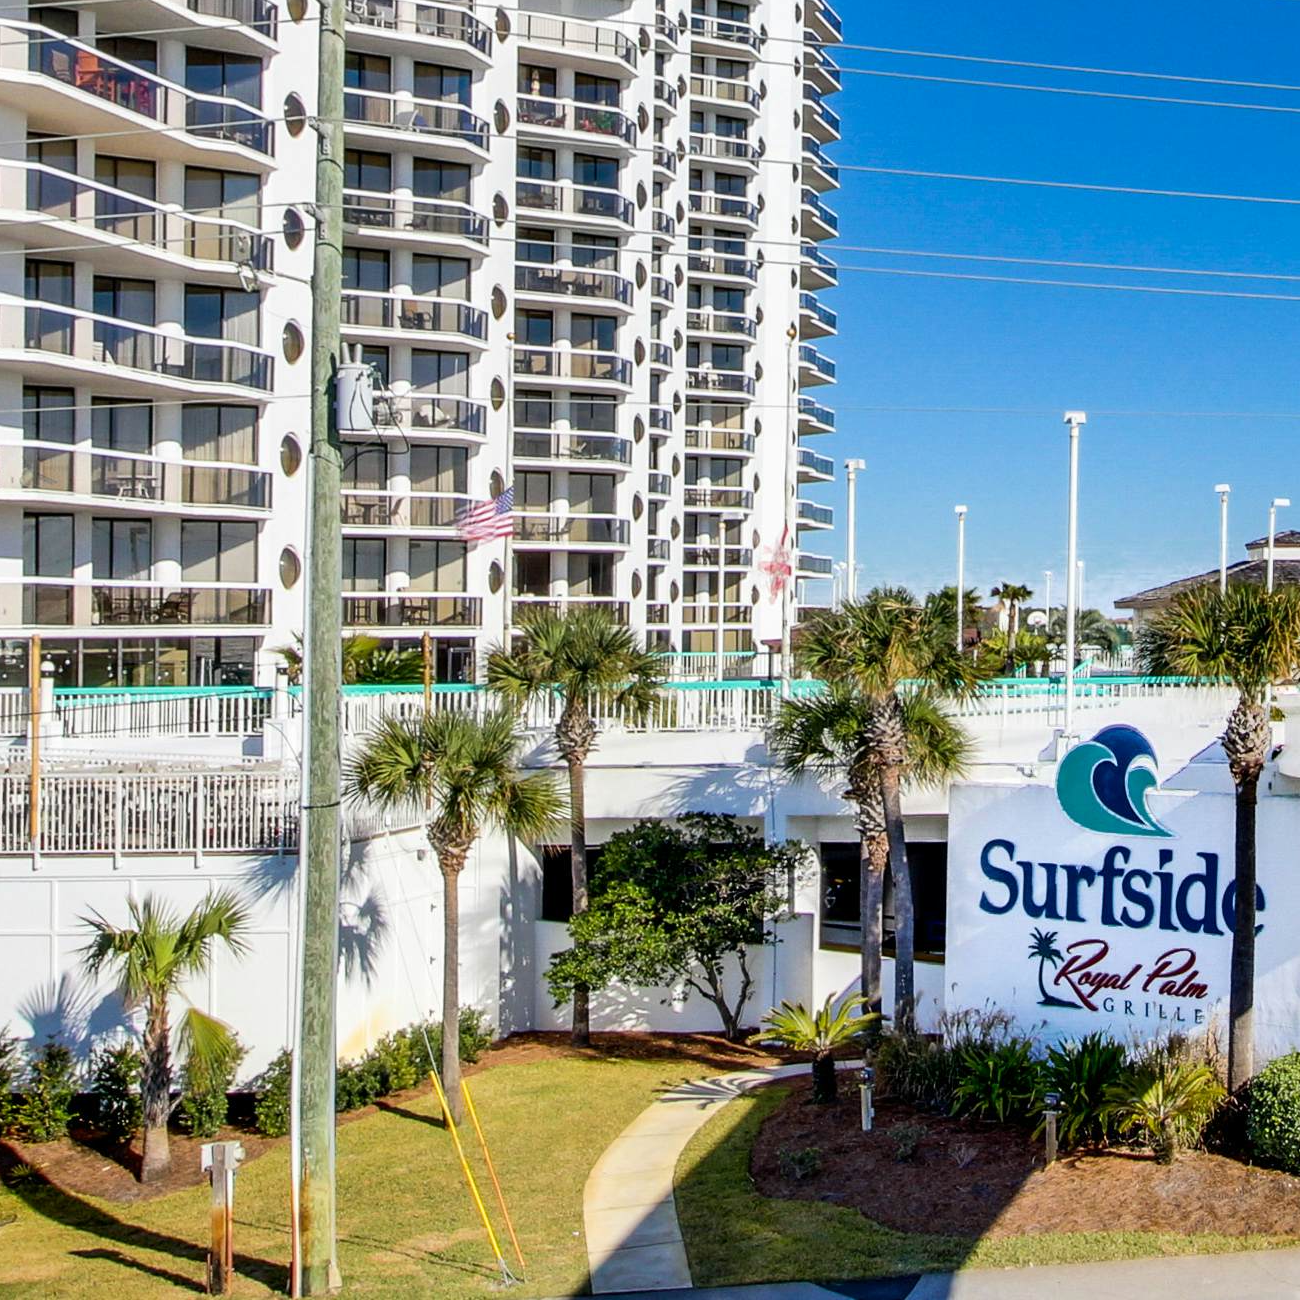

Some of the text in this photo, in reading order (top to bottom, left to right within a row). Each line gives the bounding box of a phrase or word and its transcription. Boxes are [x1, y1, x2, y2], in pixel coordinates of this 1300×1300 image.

[1054, 939, 1208, 1011] Royal Palm
[1103, 997, 1204, 1024] GRILLE
